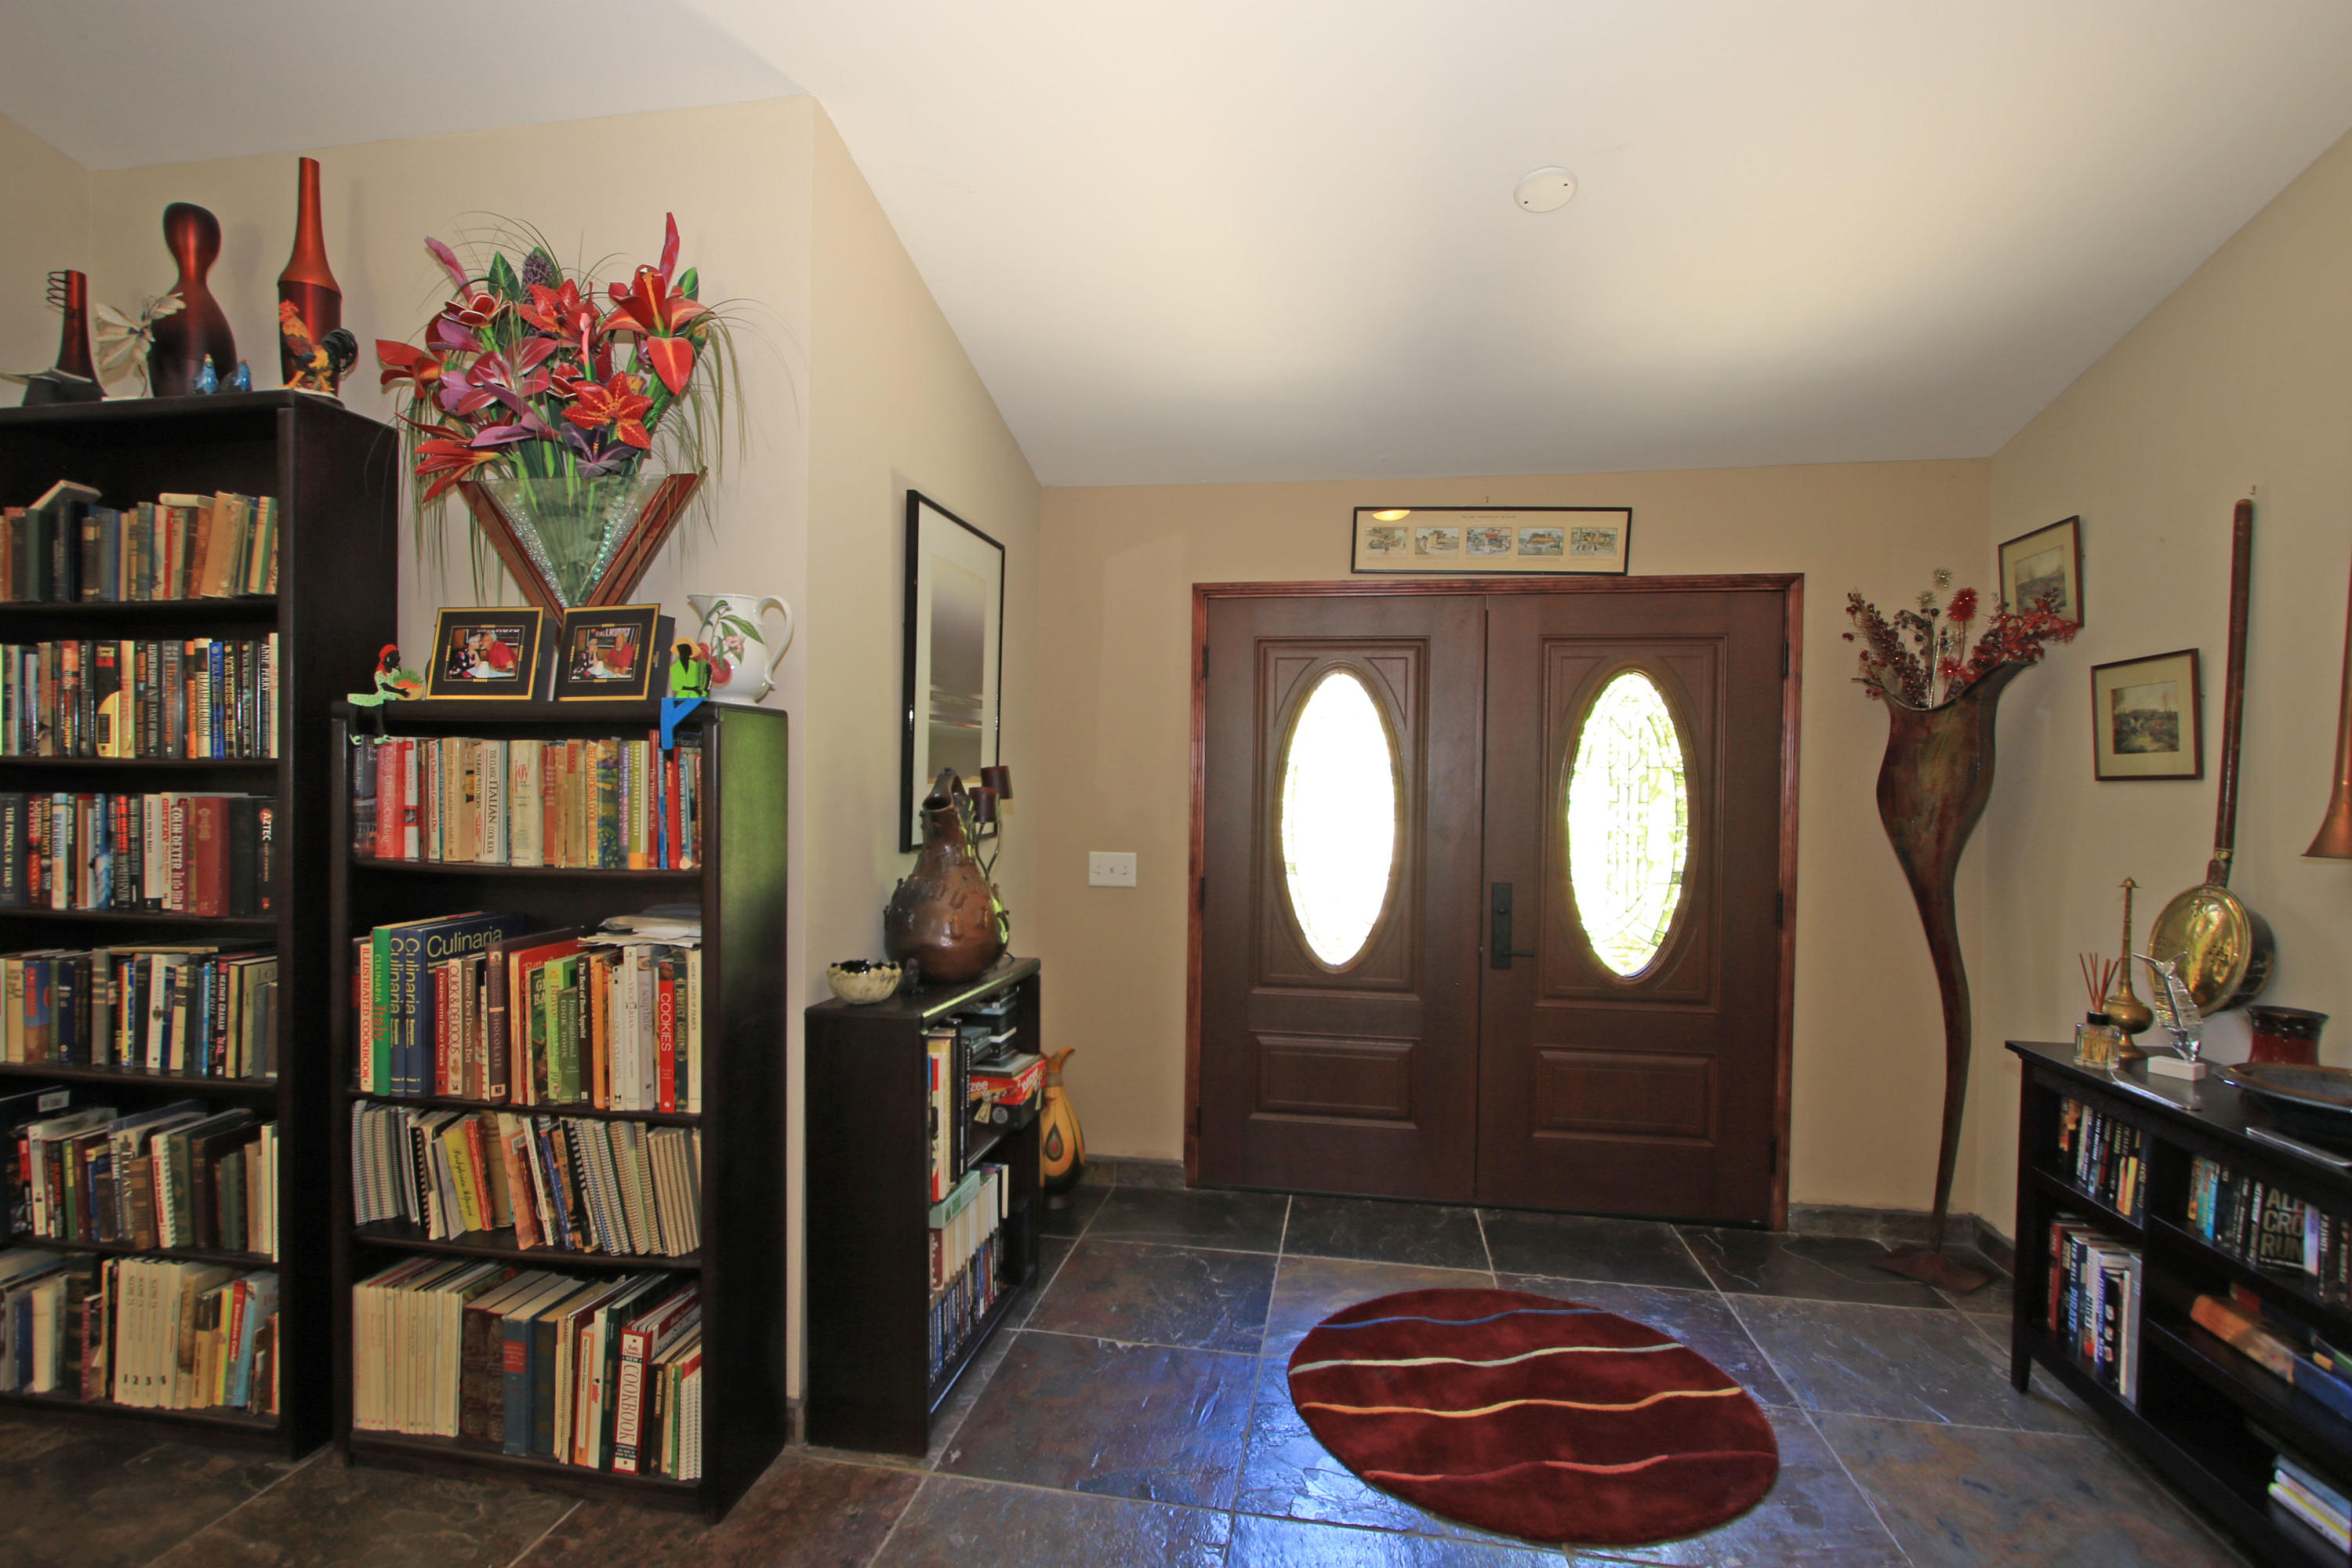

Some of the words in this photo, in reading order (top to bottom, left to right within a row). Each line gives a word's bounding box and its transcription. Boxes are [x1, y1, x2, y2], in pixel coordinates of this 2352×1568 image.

[224, 657, 234, 676] NORA
[261, 643, 270, 665] ANNE
[165, 663, 177, 708] Elizabeth
[224, 677, 234, 704] ROBERTS
[261, 668, 270, 691] PERRY
[165, 711, 177, 745] George
[587, 746, 597, 759] THE
[587, 760, 597, 802] CALIFORNIA
[4, 807, 14, 822] THE
[42, 798, 51, 819] DAVID
[488, 780, 498, 823] ITALIAN
[172, 807, 183, 833] COLIN
[263, 812, 272, 841] AZTEC
[380, 807, 392, 844] Cooking
[4, 824, 14, 851] PRINCE
[42, 822, 51, 856] BALDACCI
[53, 838, 62, 857] ROAD
[4, 854, 14, 863] OF
[172, 836, 183, 869] DEXTER
[4, 866, 14, 887] TIDES
[426, 926, 503, 958] Culinaria
[218, 975, 227, 1001] HEATHER
[362, 947, 371, 1016] ILLUSTRATED
[390, 937, 405, 1014] Culinaria
[405, 937, 420, 1014] Culinaria
[449, 965, 460, 995] QUICK
[464, 1000, 473, 1016] Best
[550, 978, 559, 1011] Bravo!
[639, 989, 650, 1011] soup
[677, 987, 686, 1018] PERFECT
[217, 1003, 226, 1030] GRAHAM
[373, 1005, 389, 1042] Italy
[449, 1007, 460, 1054] DELICIOUS
[643, 1012, 652, 1033] bible
[660, 993, 672, 1052] COOKIES
[464, 1018, 473, 1047] Desserts
[493, 1012, 502, 1069] CHOCOLATE
[677, 1022, 686, 1052] COOKING
[362, 1019, 371, 1079] COOKBOOK
[464, 1048, 473, 1064] Ever
[2266, 1189, 2304, 1210] ALE
[2264, 1210, 2304, 1235] CRO
[2259, 1232, 2304, 1261] RUN
[232, 1303, 241, 1340] Edmonton
[2069, 1287, 2078, 1333] PIRATE
[133, 1375, 139, 1385] 2
[146, 1376, 151, 1386] 3
[619, 1364, 641, 1441] COOKBOOK
